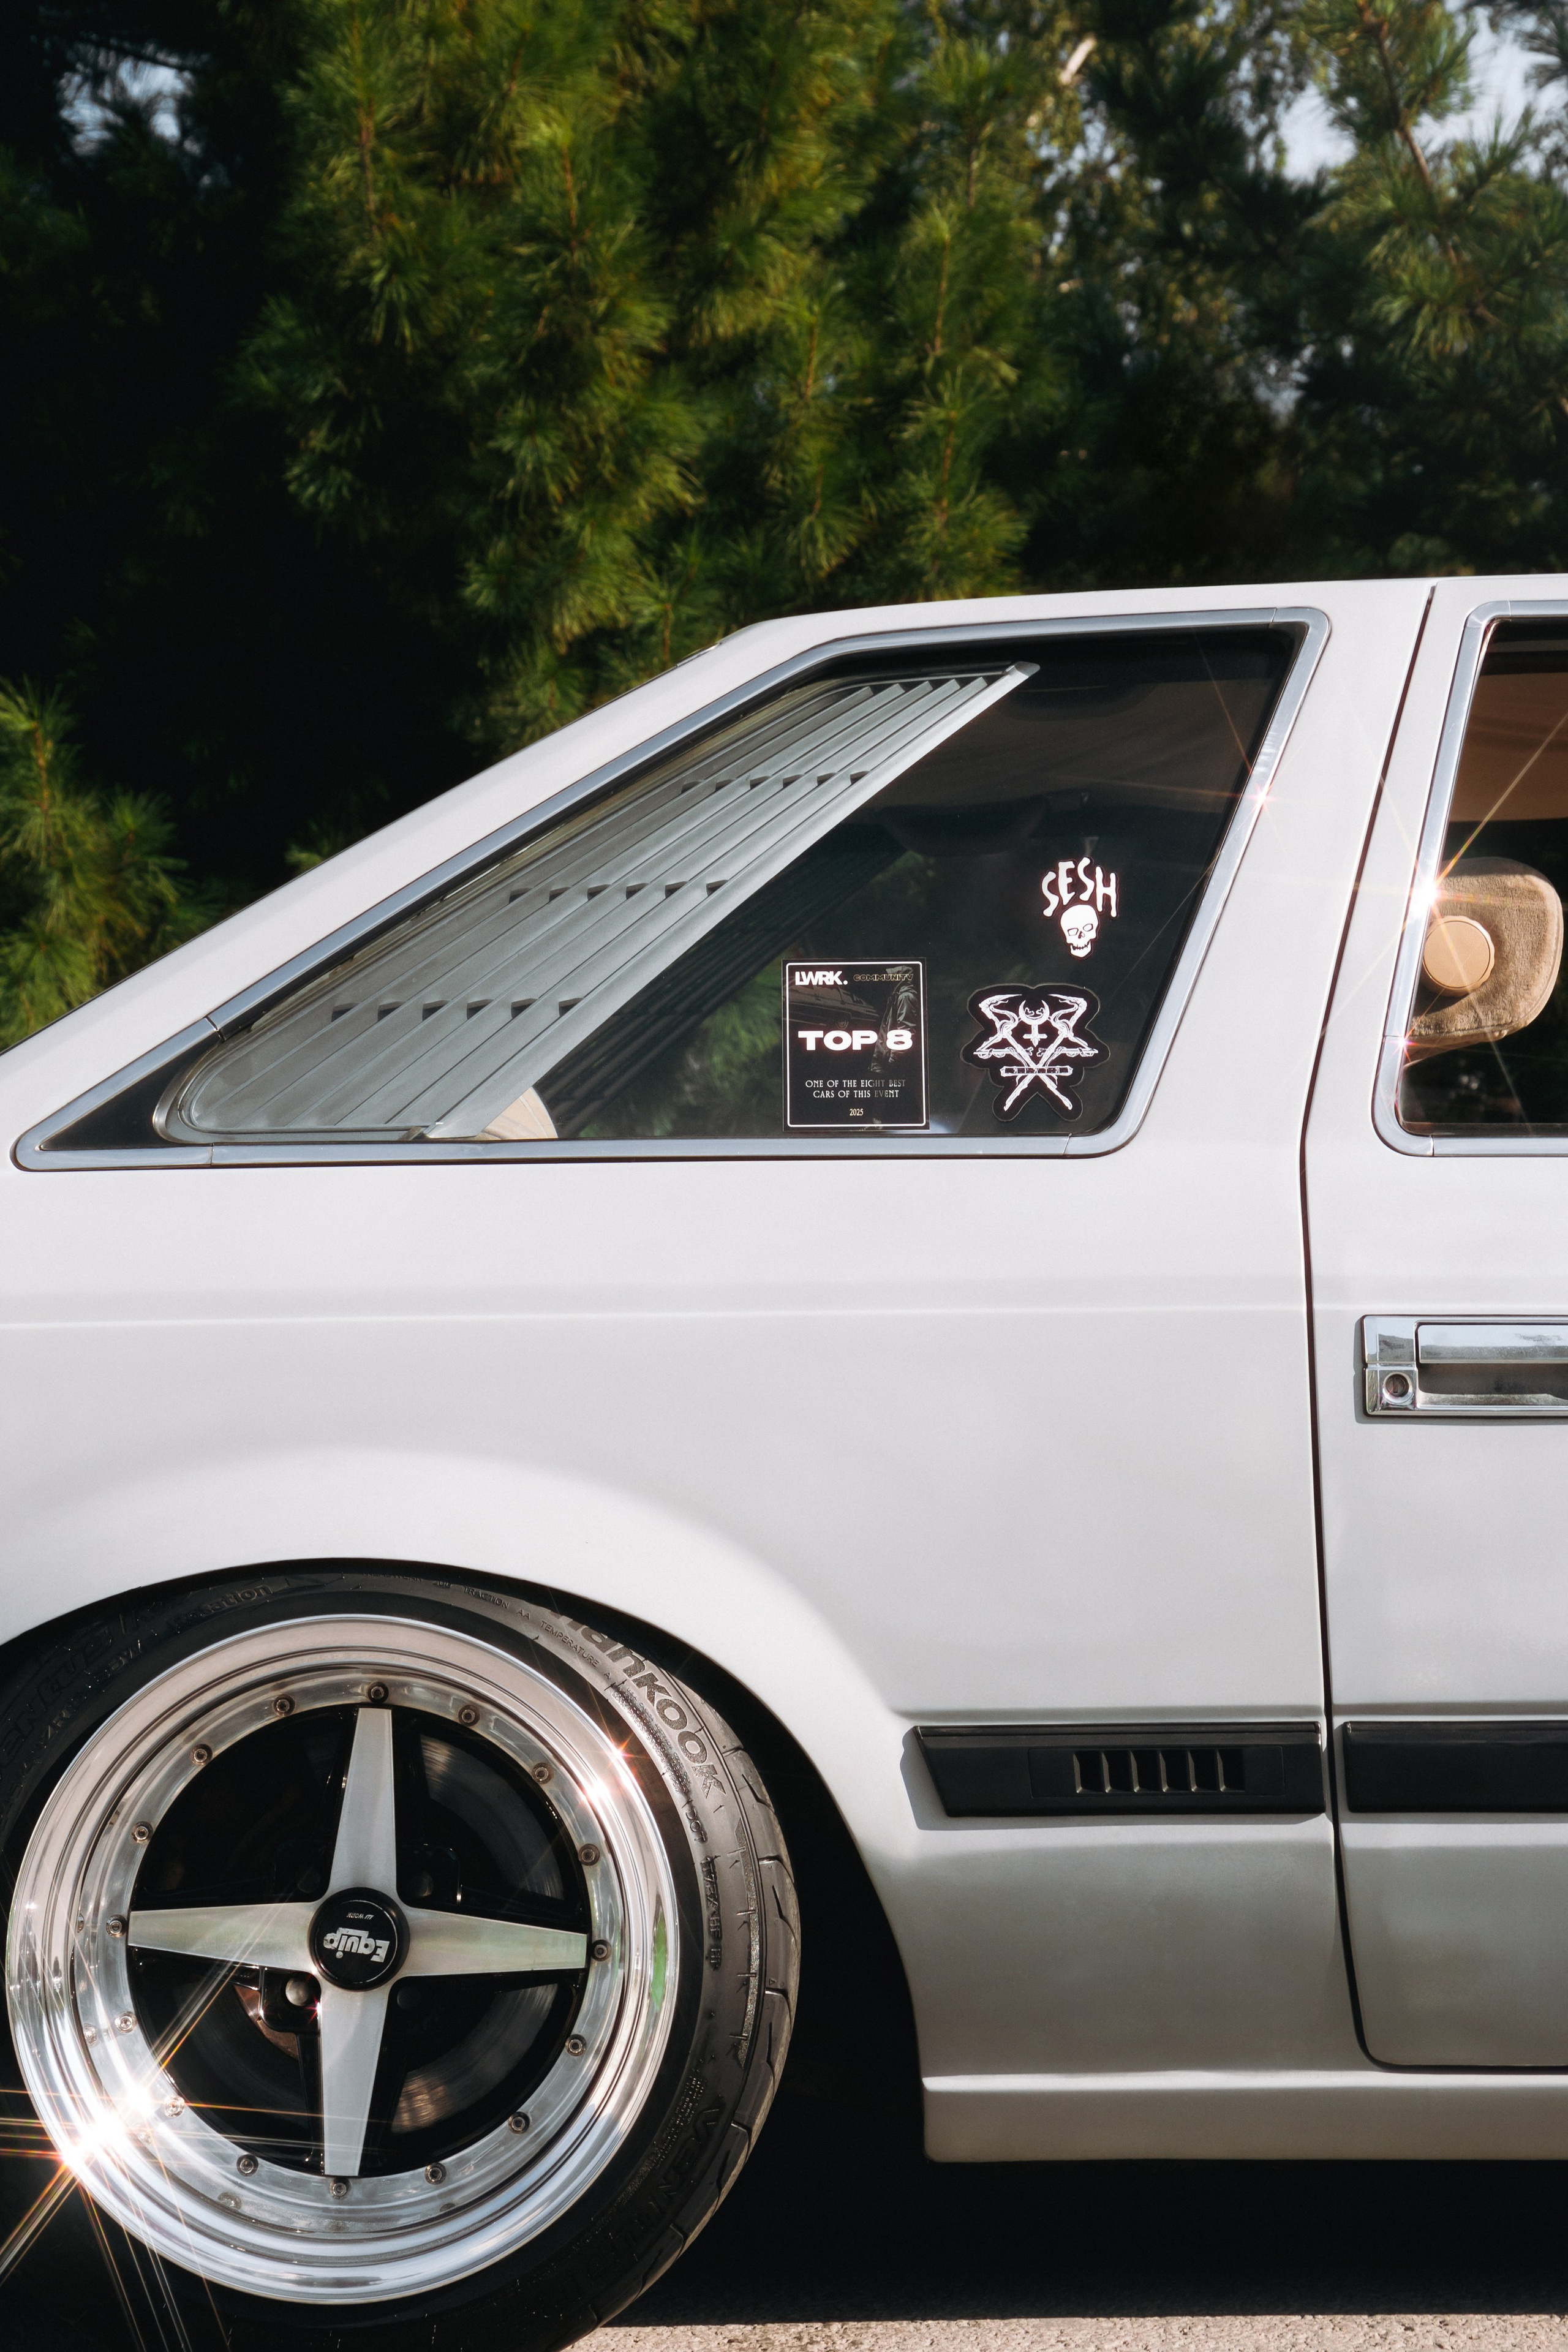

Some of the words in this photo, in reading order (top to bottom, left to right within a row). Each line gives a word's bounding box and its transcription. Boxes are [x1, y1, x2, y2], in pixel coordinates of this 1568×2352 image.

[1041, 856, 1117, 918] SESH
[795, 971, 848, 986] LWRK.
[798, 1030, 878, 1051] TOP
[886, 1029, 913, 1051] 8
[463, 1586, 510, 1609] TRACTION
[516, 1608, 531, 1620] AA
[541, 1620, 600, 1668] TEMPERATURE
[685, 1808, 706, 1843] DOT
[323, 1927, 390, 1963] Equip
